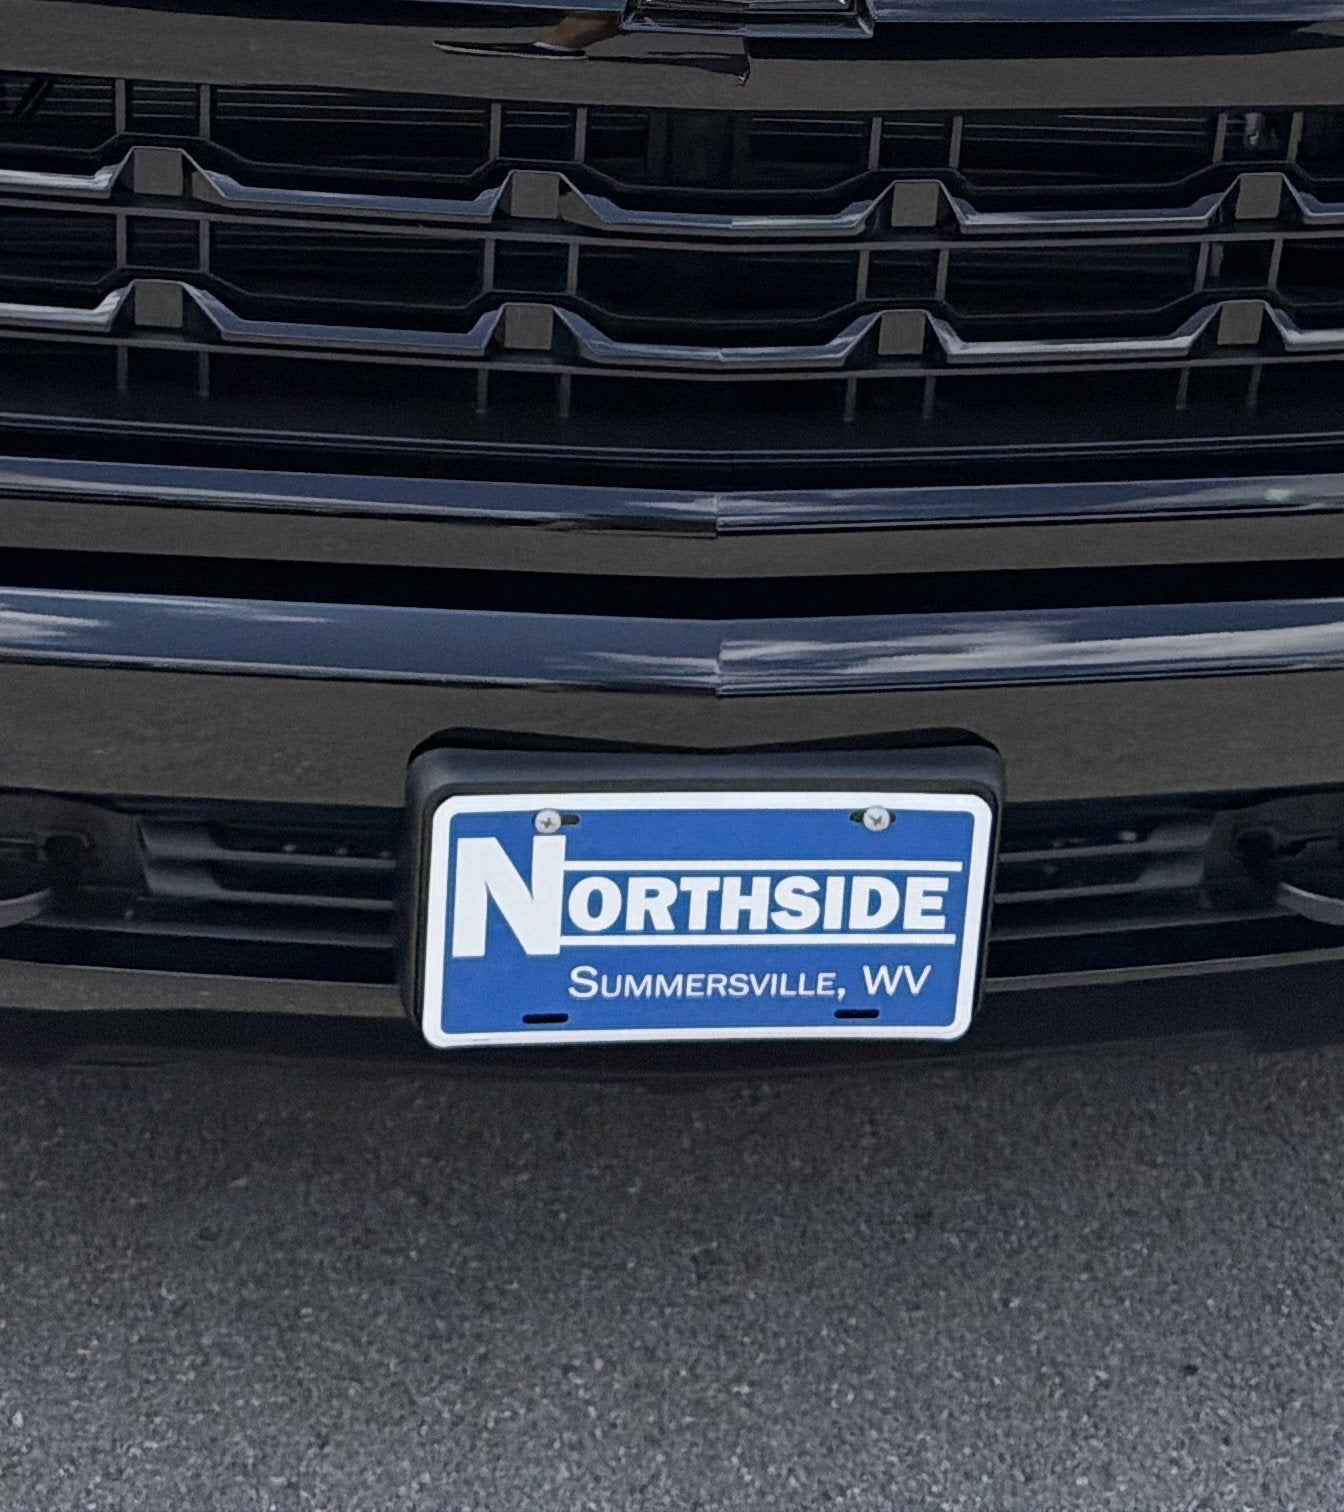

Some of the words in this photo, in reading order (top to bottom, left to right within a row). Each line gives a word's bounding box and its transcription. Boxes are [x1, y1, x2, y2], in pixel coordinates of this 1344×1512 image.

[452, 834, 950, 958] NORTHSIDE
[568, 965, 846, 1001] SUMMERSVILLE,
[863, 964, 932, 996] WV
